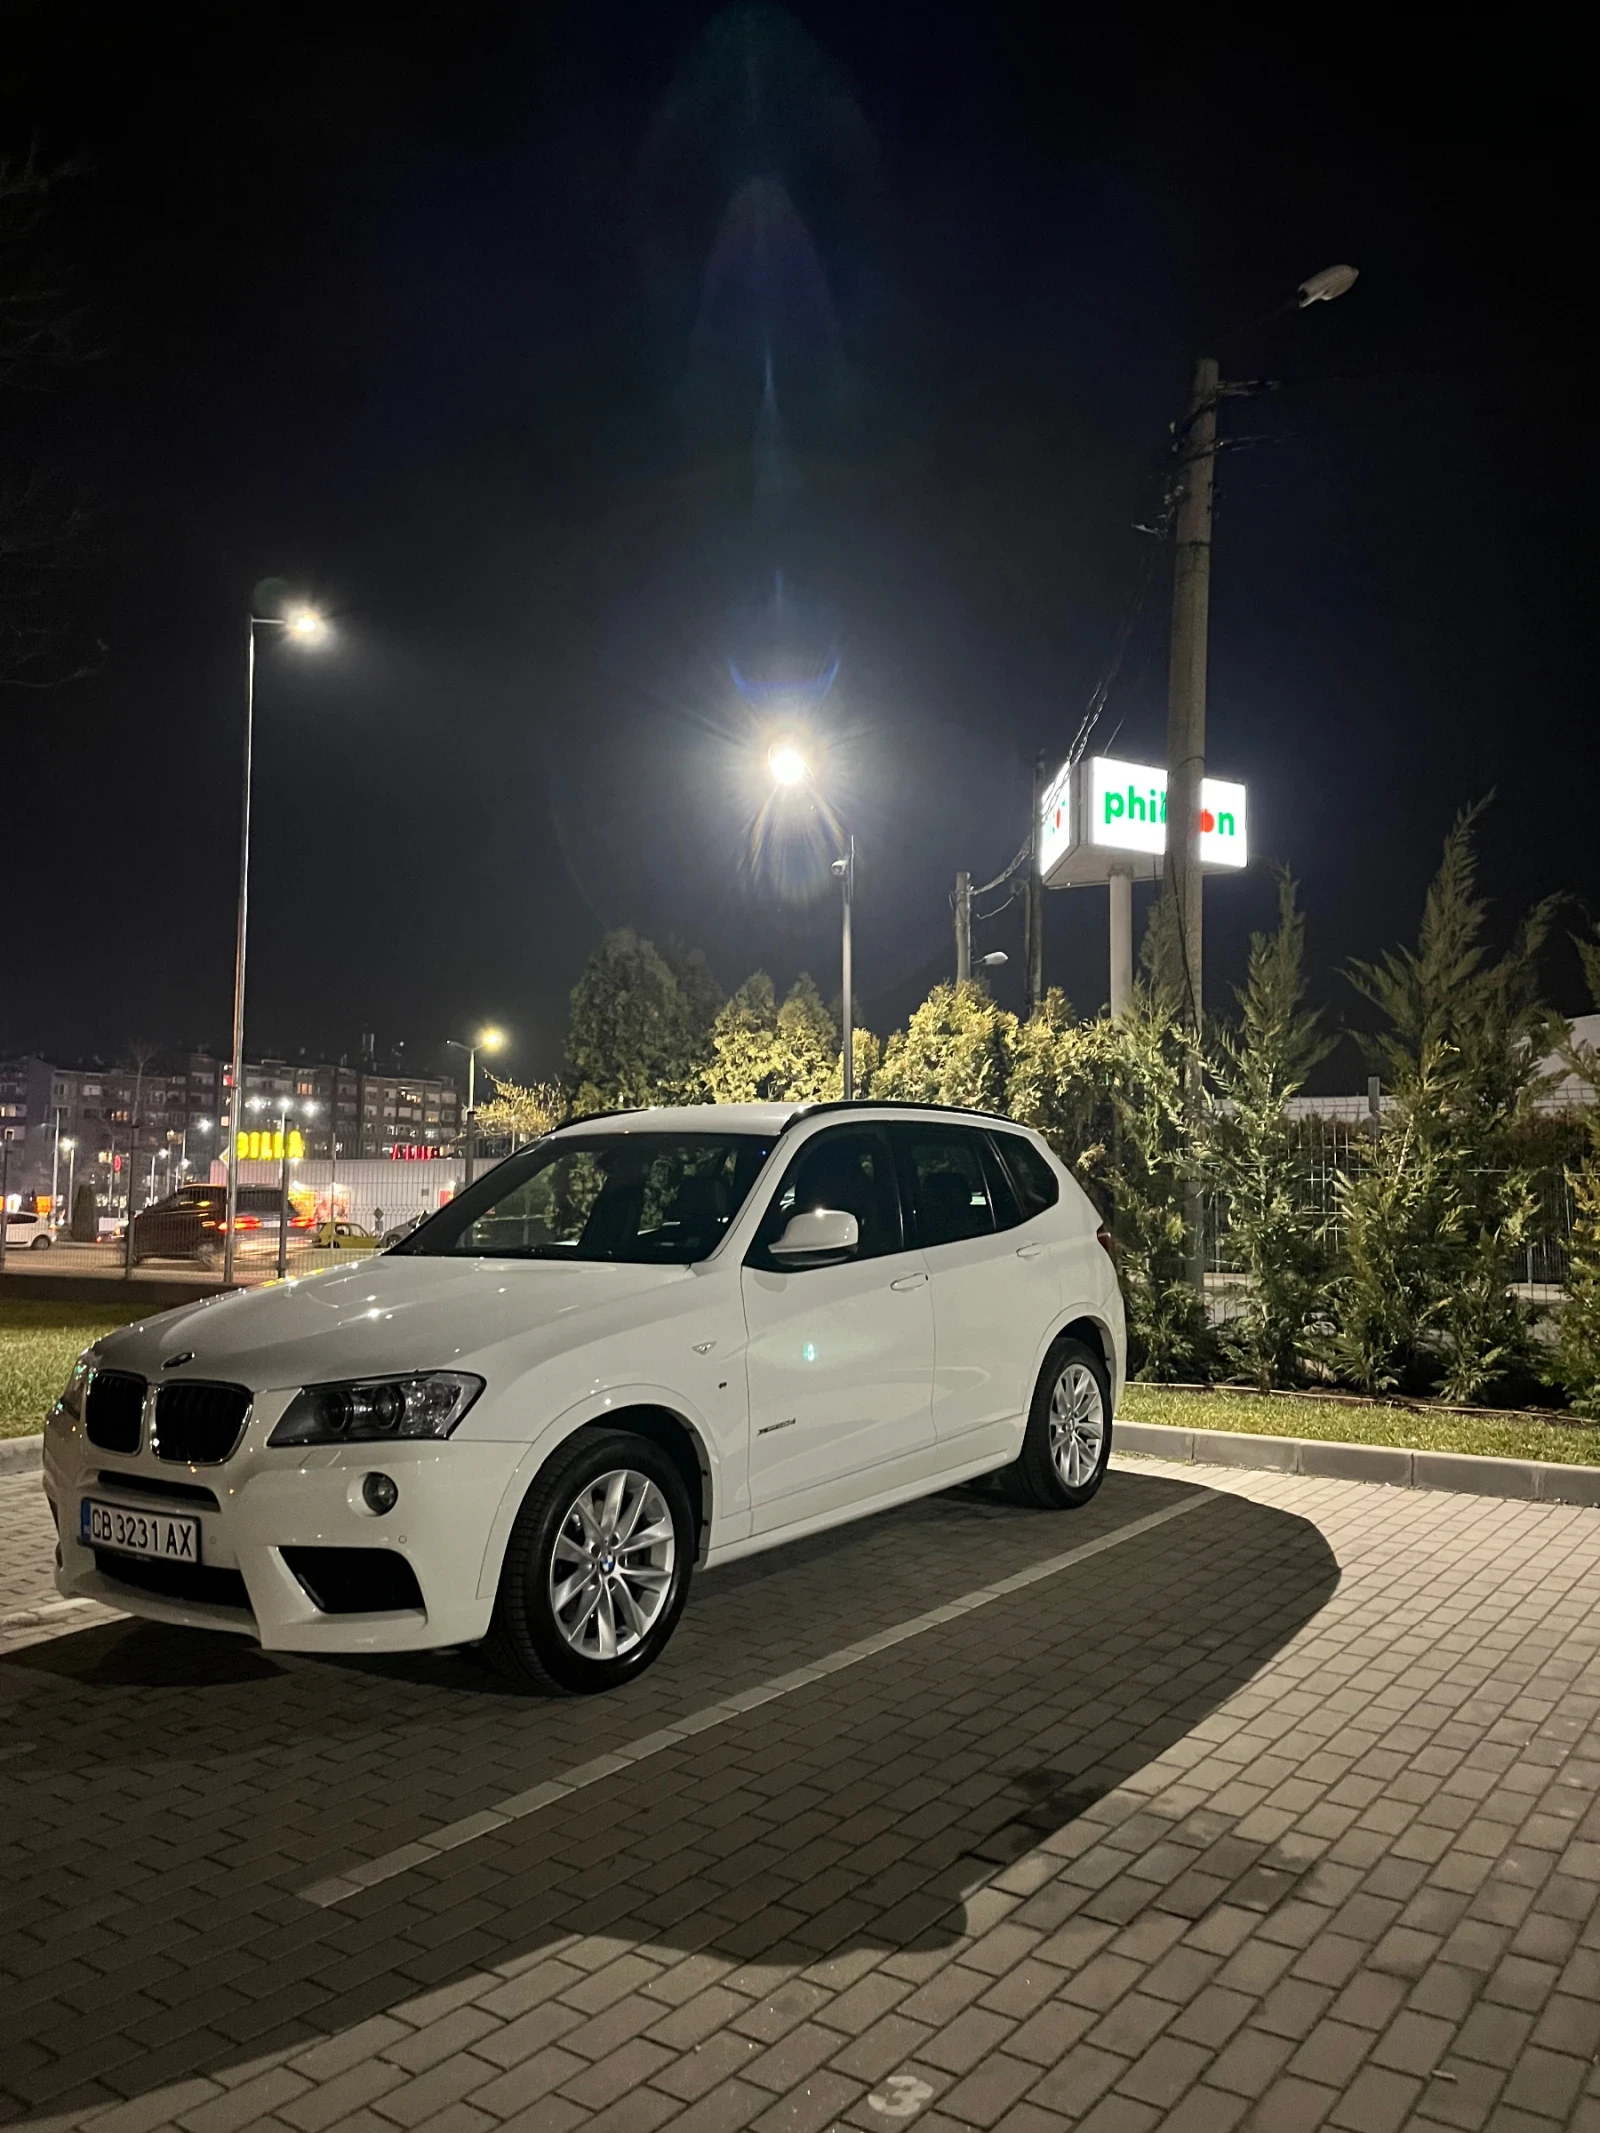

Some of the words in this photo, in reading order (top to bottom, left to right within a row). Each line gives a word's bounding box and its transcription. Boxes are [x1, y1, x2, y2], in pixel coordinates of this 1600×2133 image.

[116, 1514, 158, 1552] 3231
[165, 1522, 192, 1557] AX
[867, 2075, 934, 2116] 3
